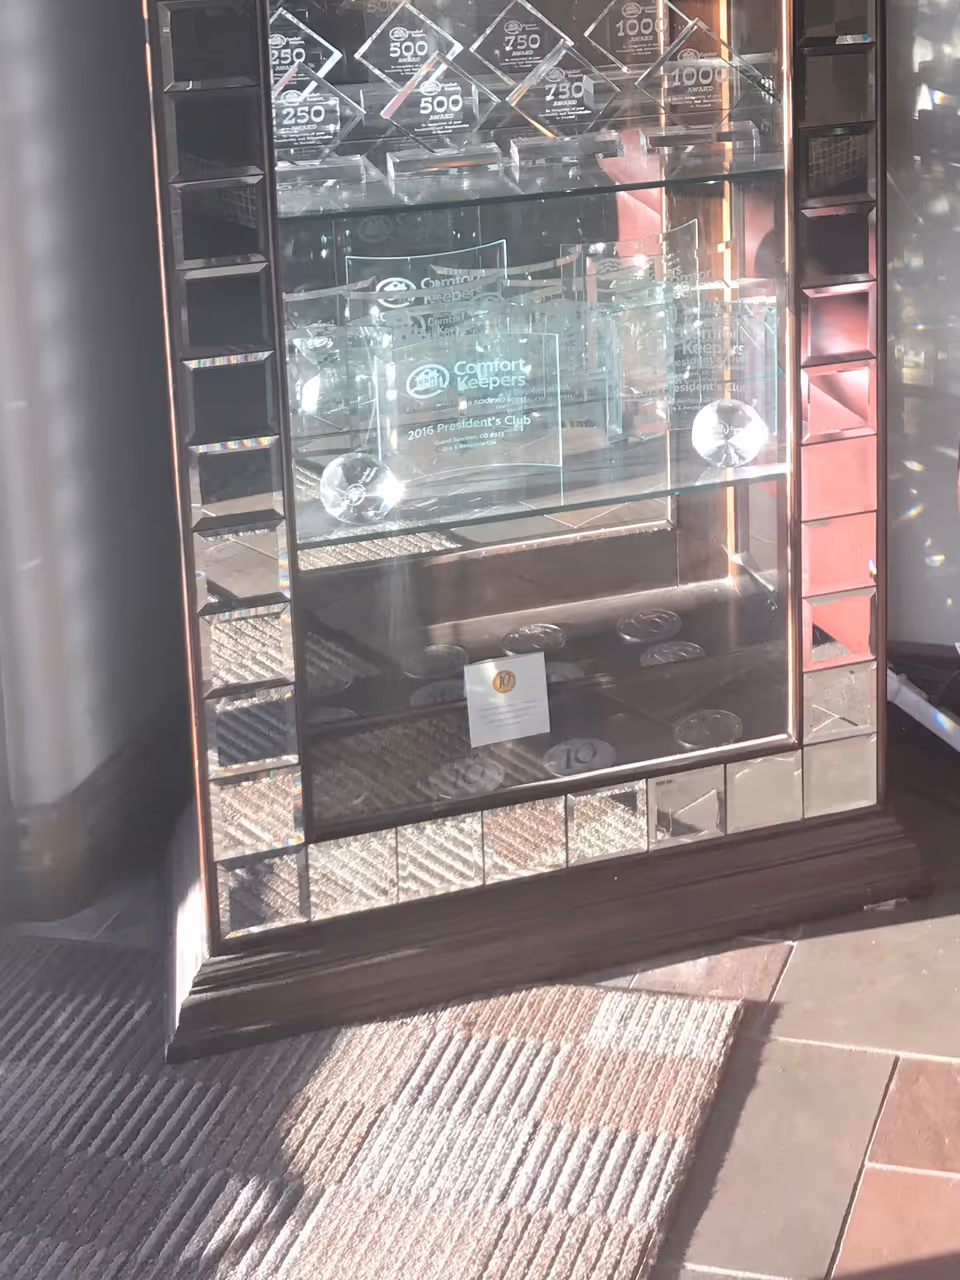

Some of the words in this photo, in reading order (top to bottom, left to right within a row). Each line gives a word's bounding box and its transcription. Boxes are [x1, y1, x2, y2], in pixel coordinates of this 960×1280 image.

[616, 18, 667, 36] 1000
[390, 41, 428, 57] 500
[504, 34, 540, 51] 750
[271, 48, 305, 65] 250
[671, 67, 729, 87] 1000
[545, 82, 584, 101] 750
[420, 95, 462, 114] 500
[282, 106, 325, 125] 250
[454, 358, 526, 376] Comfort
[457, 376, 527, 391] Keepers
[407, 425, 434, 440] 2016
[437, 416, 501, 433] President's
[505, 415, 531, 425] Club
[564, 741, 597, 770] 10
